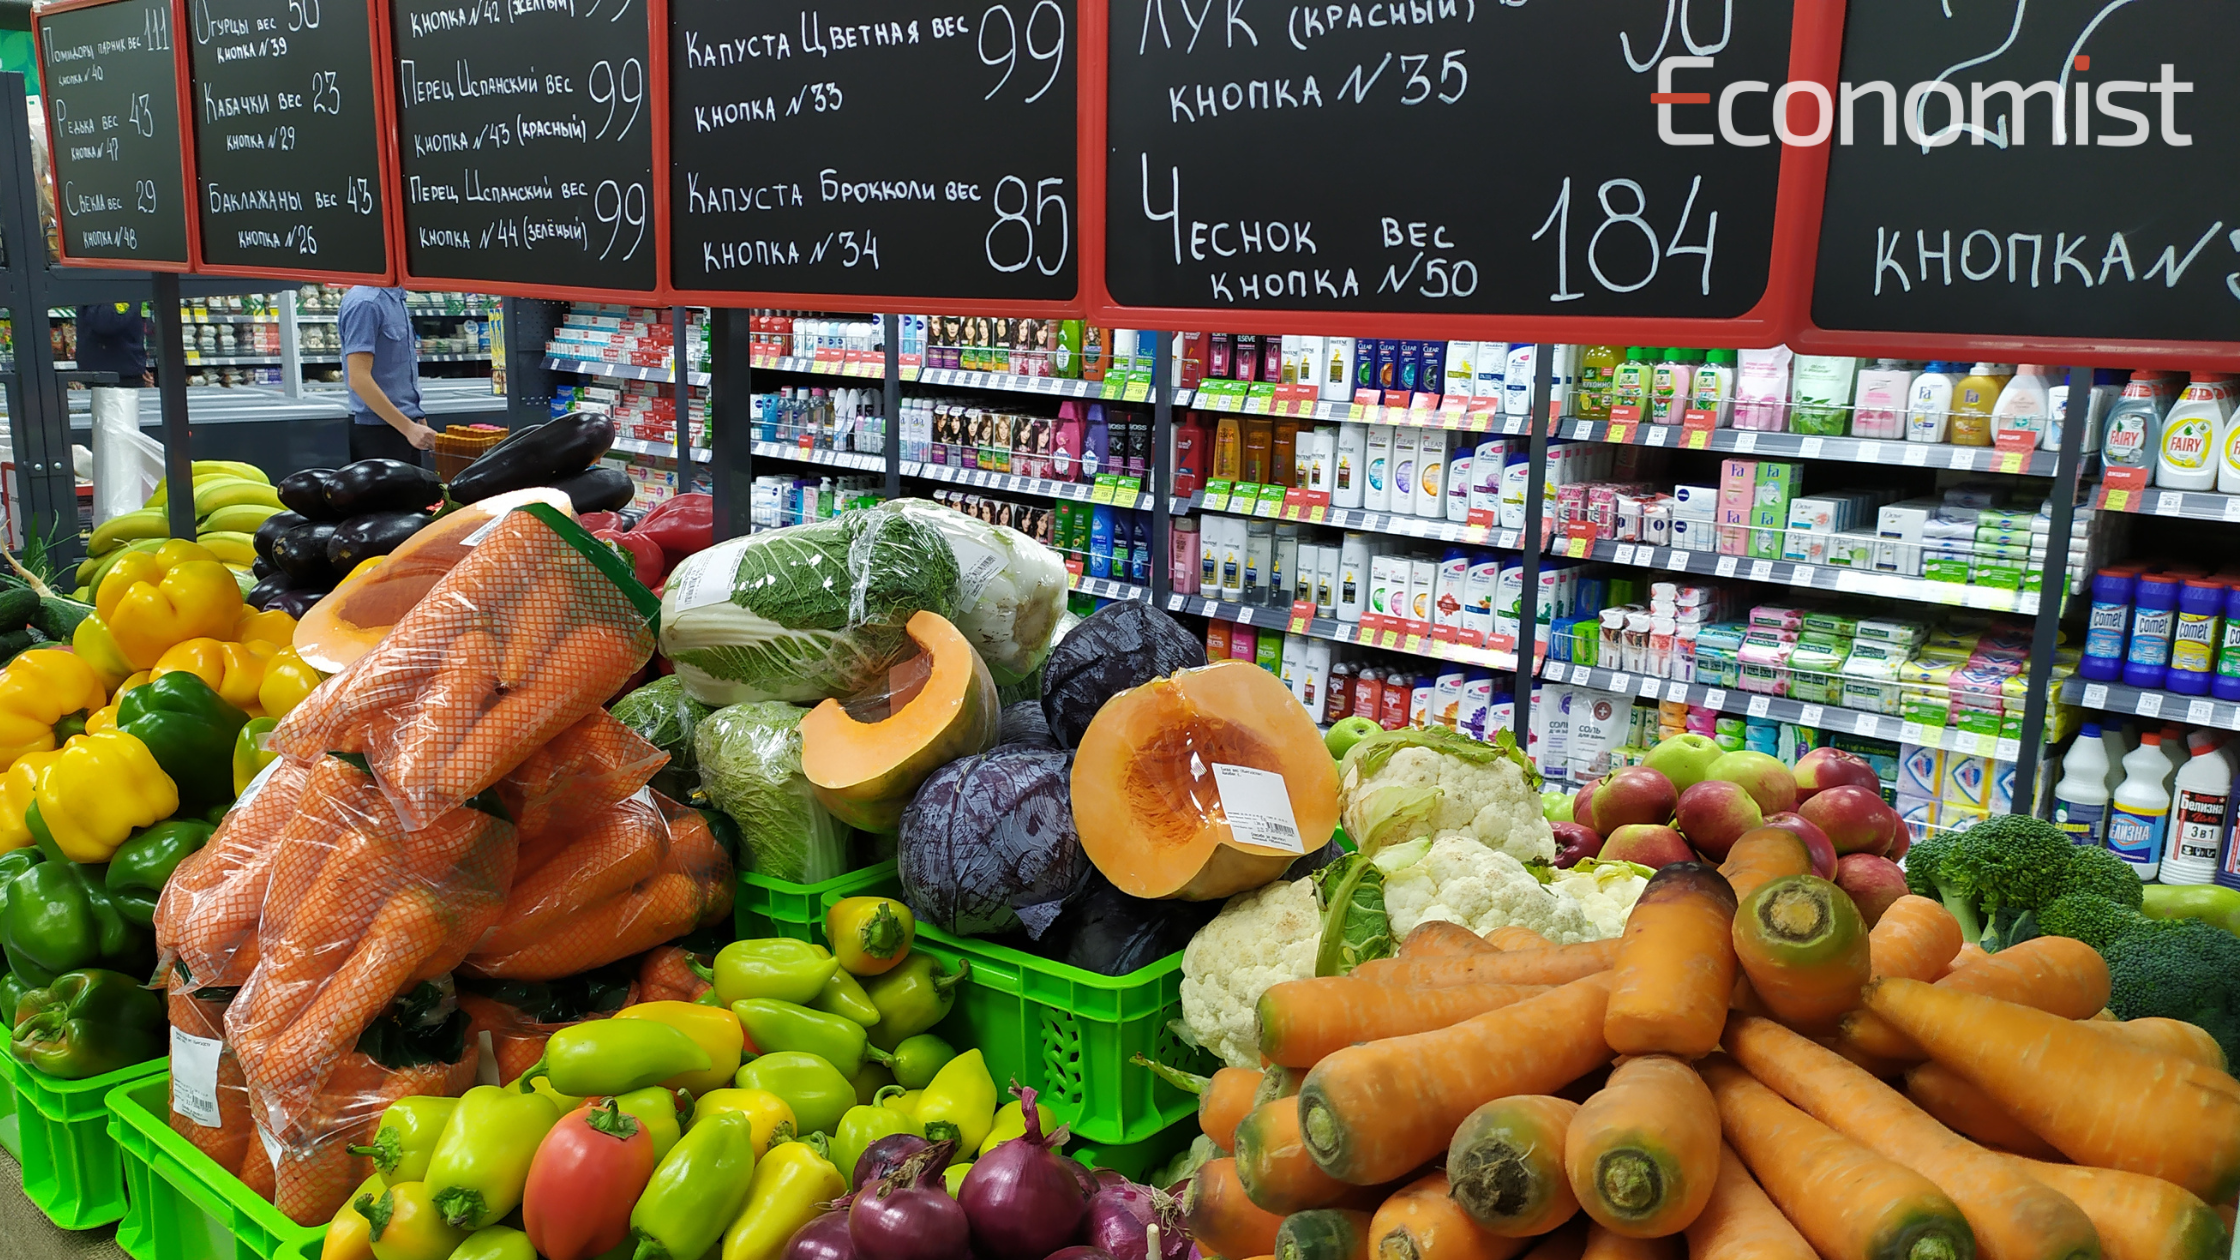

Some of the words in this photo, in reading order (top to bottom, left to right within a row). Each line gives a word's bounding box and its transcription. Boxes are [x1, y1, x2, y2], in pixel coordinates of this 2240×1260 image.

[144, 7, 169, 51] 111
[685, 30, 791, 69] КАПУСТА
[976, 0, 1065, 104] 99
[312, 71, 340, 115] 23
[588, 57, 642, 142] 99
[1168, 74, 1323, 123] КНОПКА
[129, 92, 153, 138] 43
[694, 97, 776, 133] КНОПКА
[135, 180, 157, 214] 29
[347, 176, 373, 215] 43
[594, 179, 646, 261] 99
[686, 171, 803, 214] КАПУСТА
[984, 174, 1069, 277] 85
[1141, 152, 1318, 265] ЧЕСНОК
[1381, 216, 1455, 250] ВЕС
[1531, 175, 1719, 302] 184
[703, 239, 800, 274] КНОПКА
[1873, 226, 2137, 297] КНОПКА
[1210, 267, 1360, 303] КНОПКА
[2109, 430, 2139, 446] FAIRY
[2169, 436, 2203, 453] FAIRY
[1731, 463, 1745, 477] Fa
[1766, 464, 1780, 478] Fa
[1760, 512, 1774, 525] Fa
[2093, 610, 2122, 628] comet
[2139, 616, 2169, 634] comet
[2179, 620, 2208, 640] comet
[2180, 794, 2224, 815] Белизна
[2109, 824, 2150, 841] ЕЛИЗНА
[2190, 826, 2199, 838] 3
[2208, 828, 2215, 840] 1
